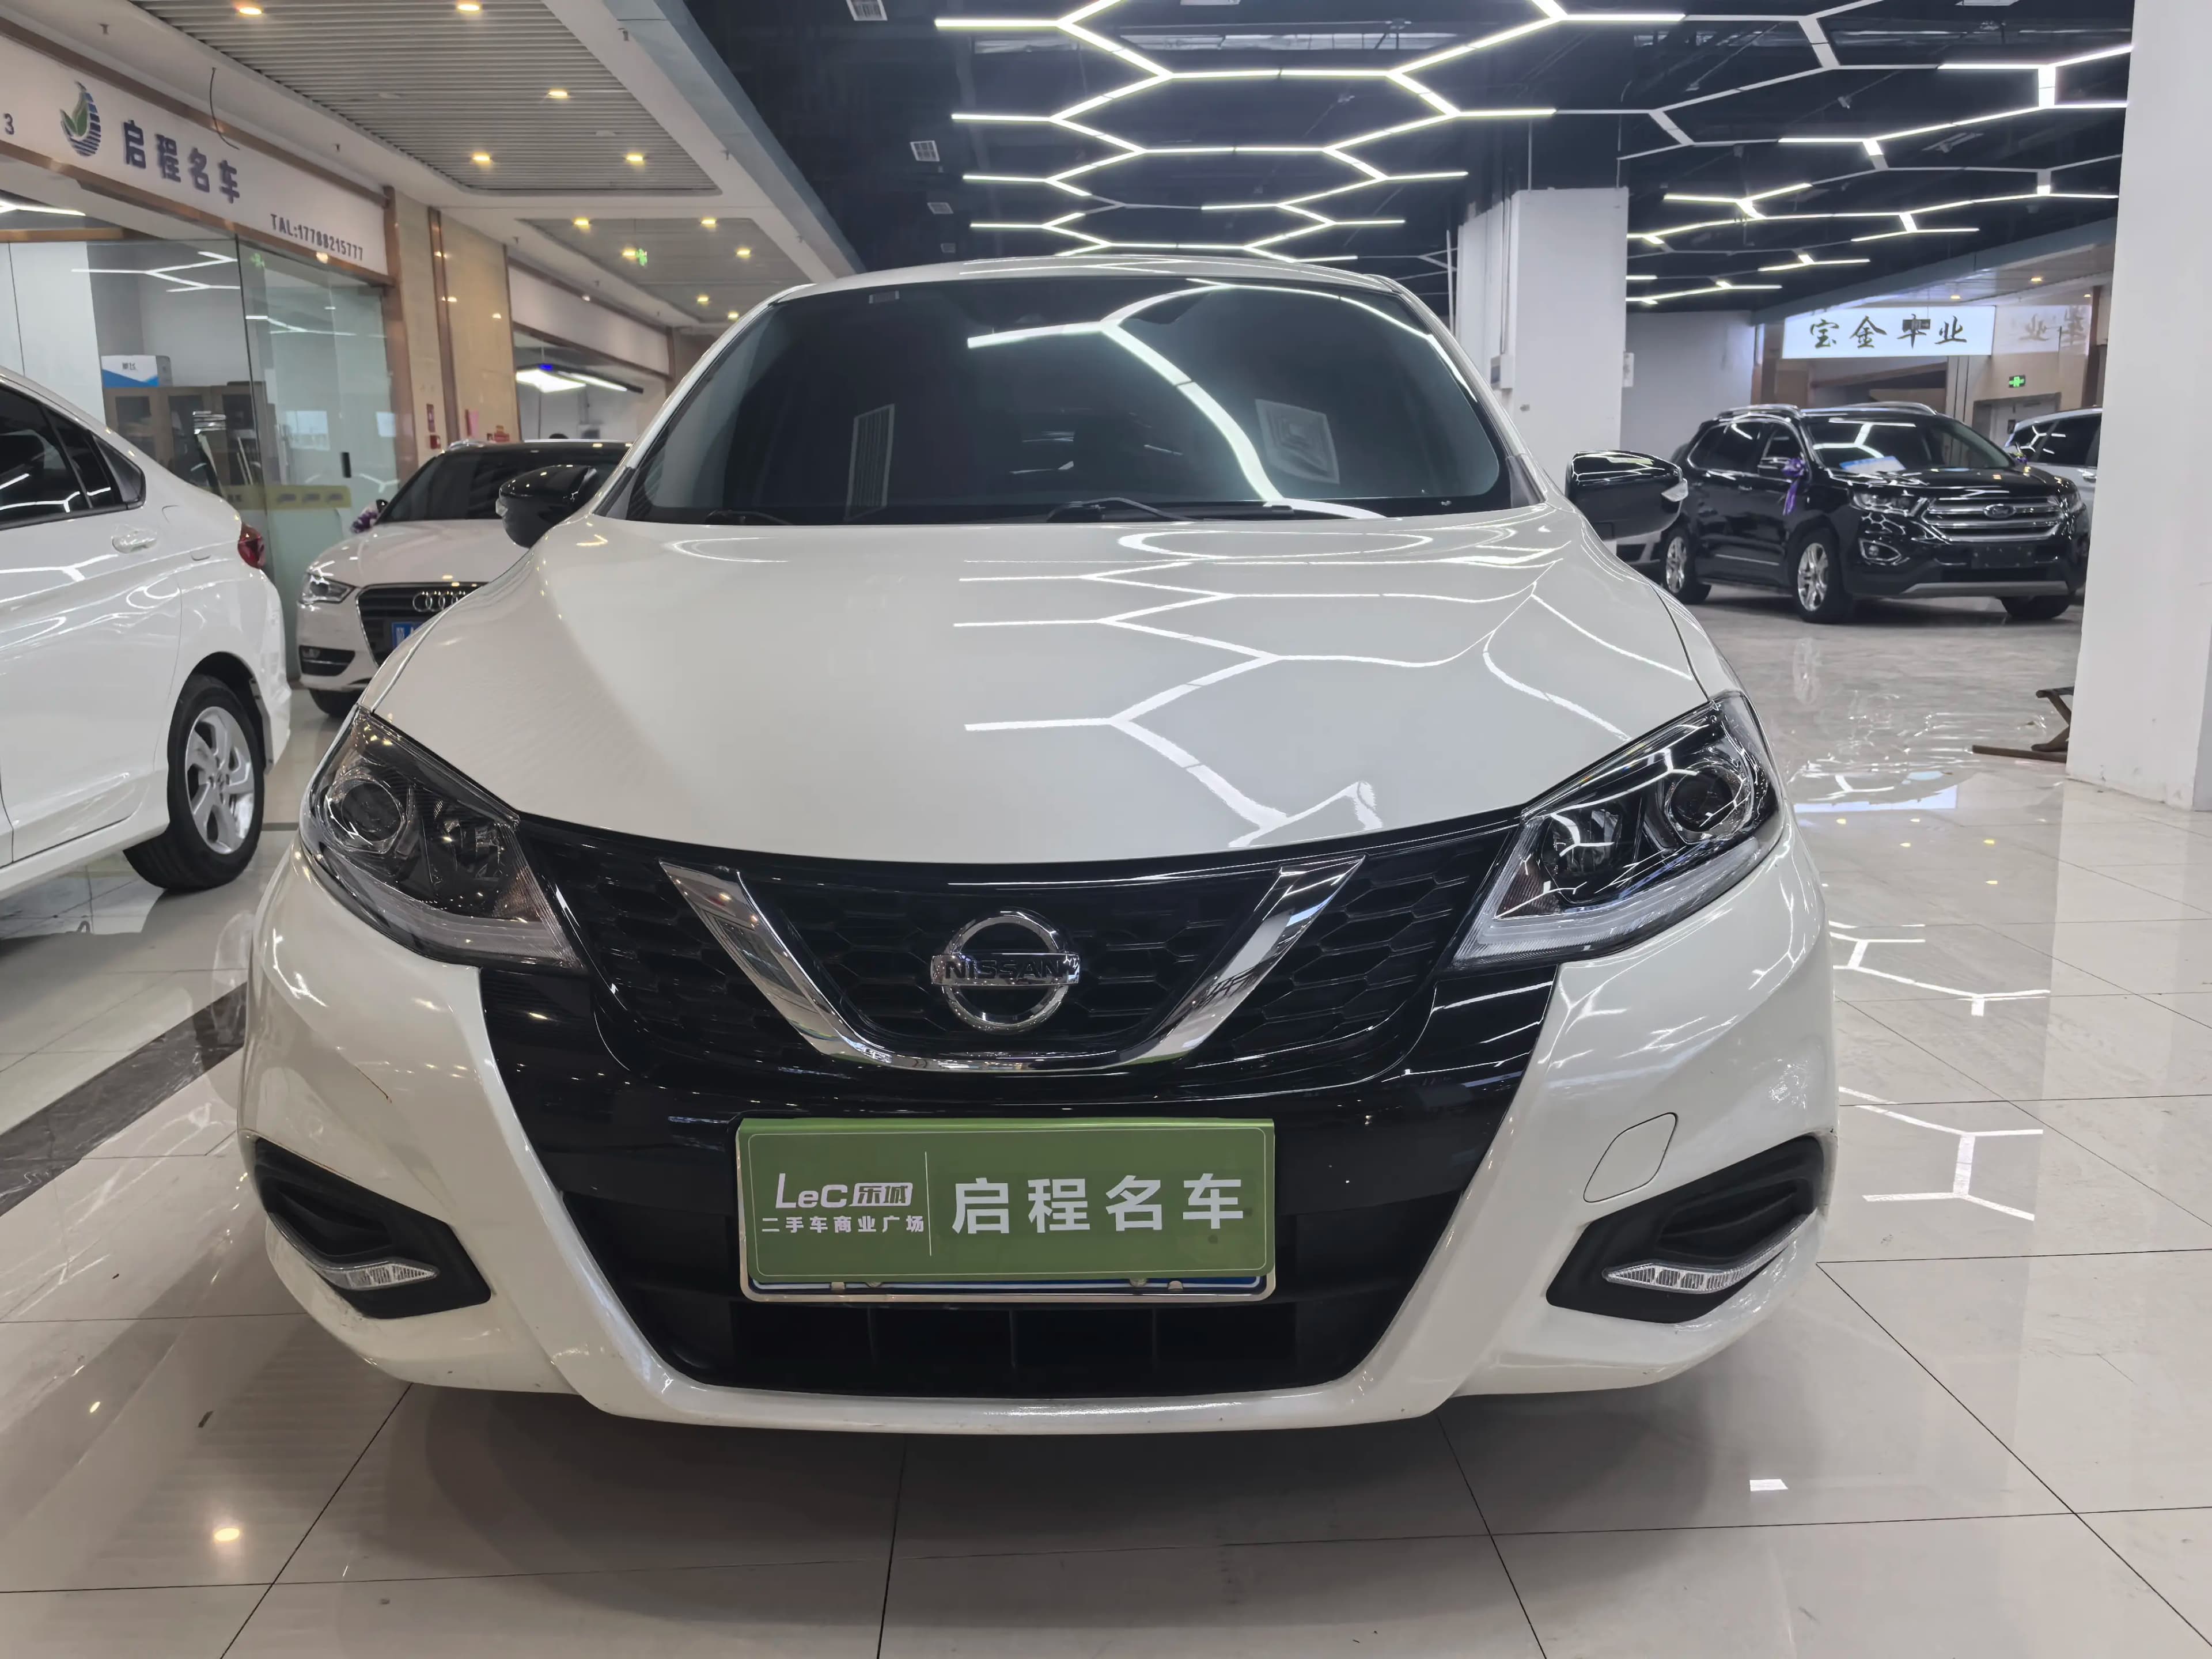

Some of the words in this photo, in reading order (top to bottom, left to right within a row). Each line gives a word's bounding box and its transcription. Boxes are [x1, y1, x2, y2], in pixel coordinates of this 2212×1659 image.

[123, 119, 240, 204] 启程名车
[945, 960, 1063, 979] NISSAN
[952, 1173, 1244, 1234] 启程名车
[762, 1215, 924, 1233] 二手车商业广场
